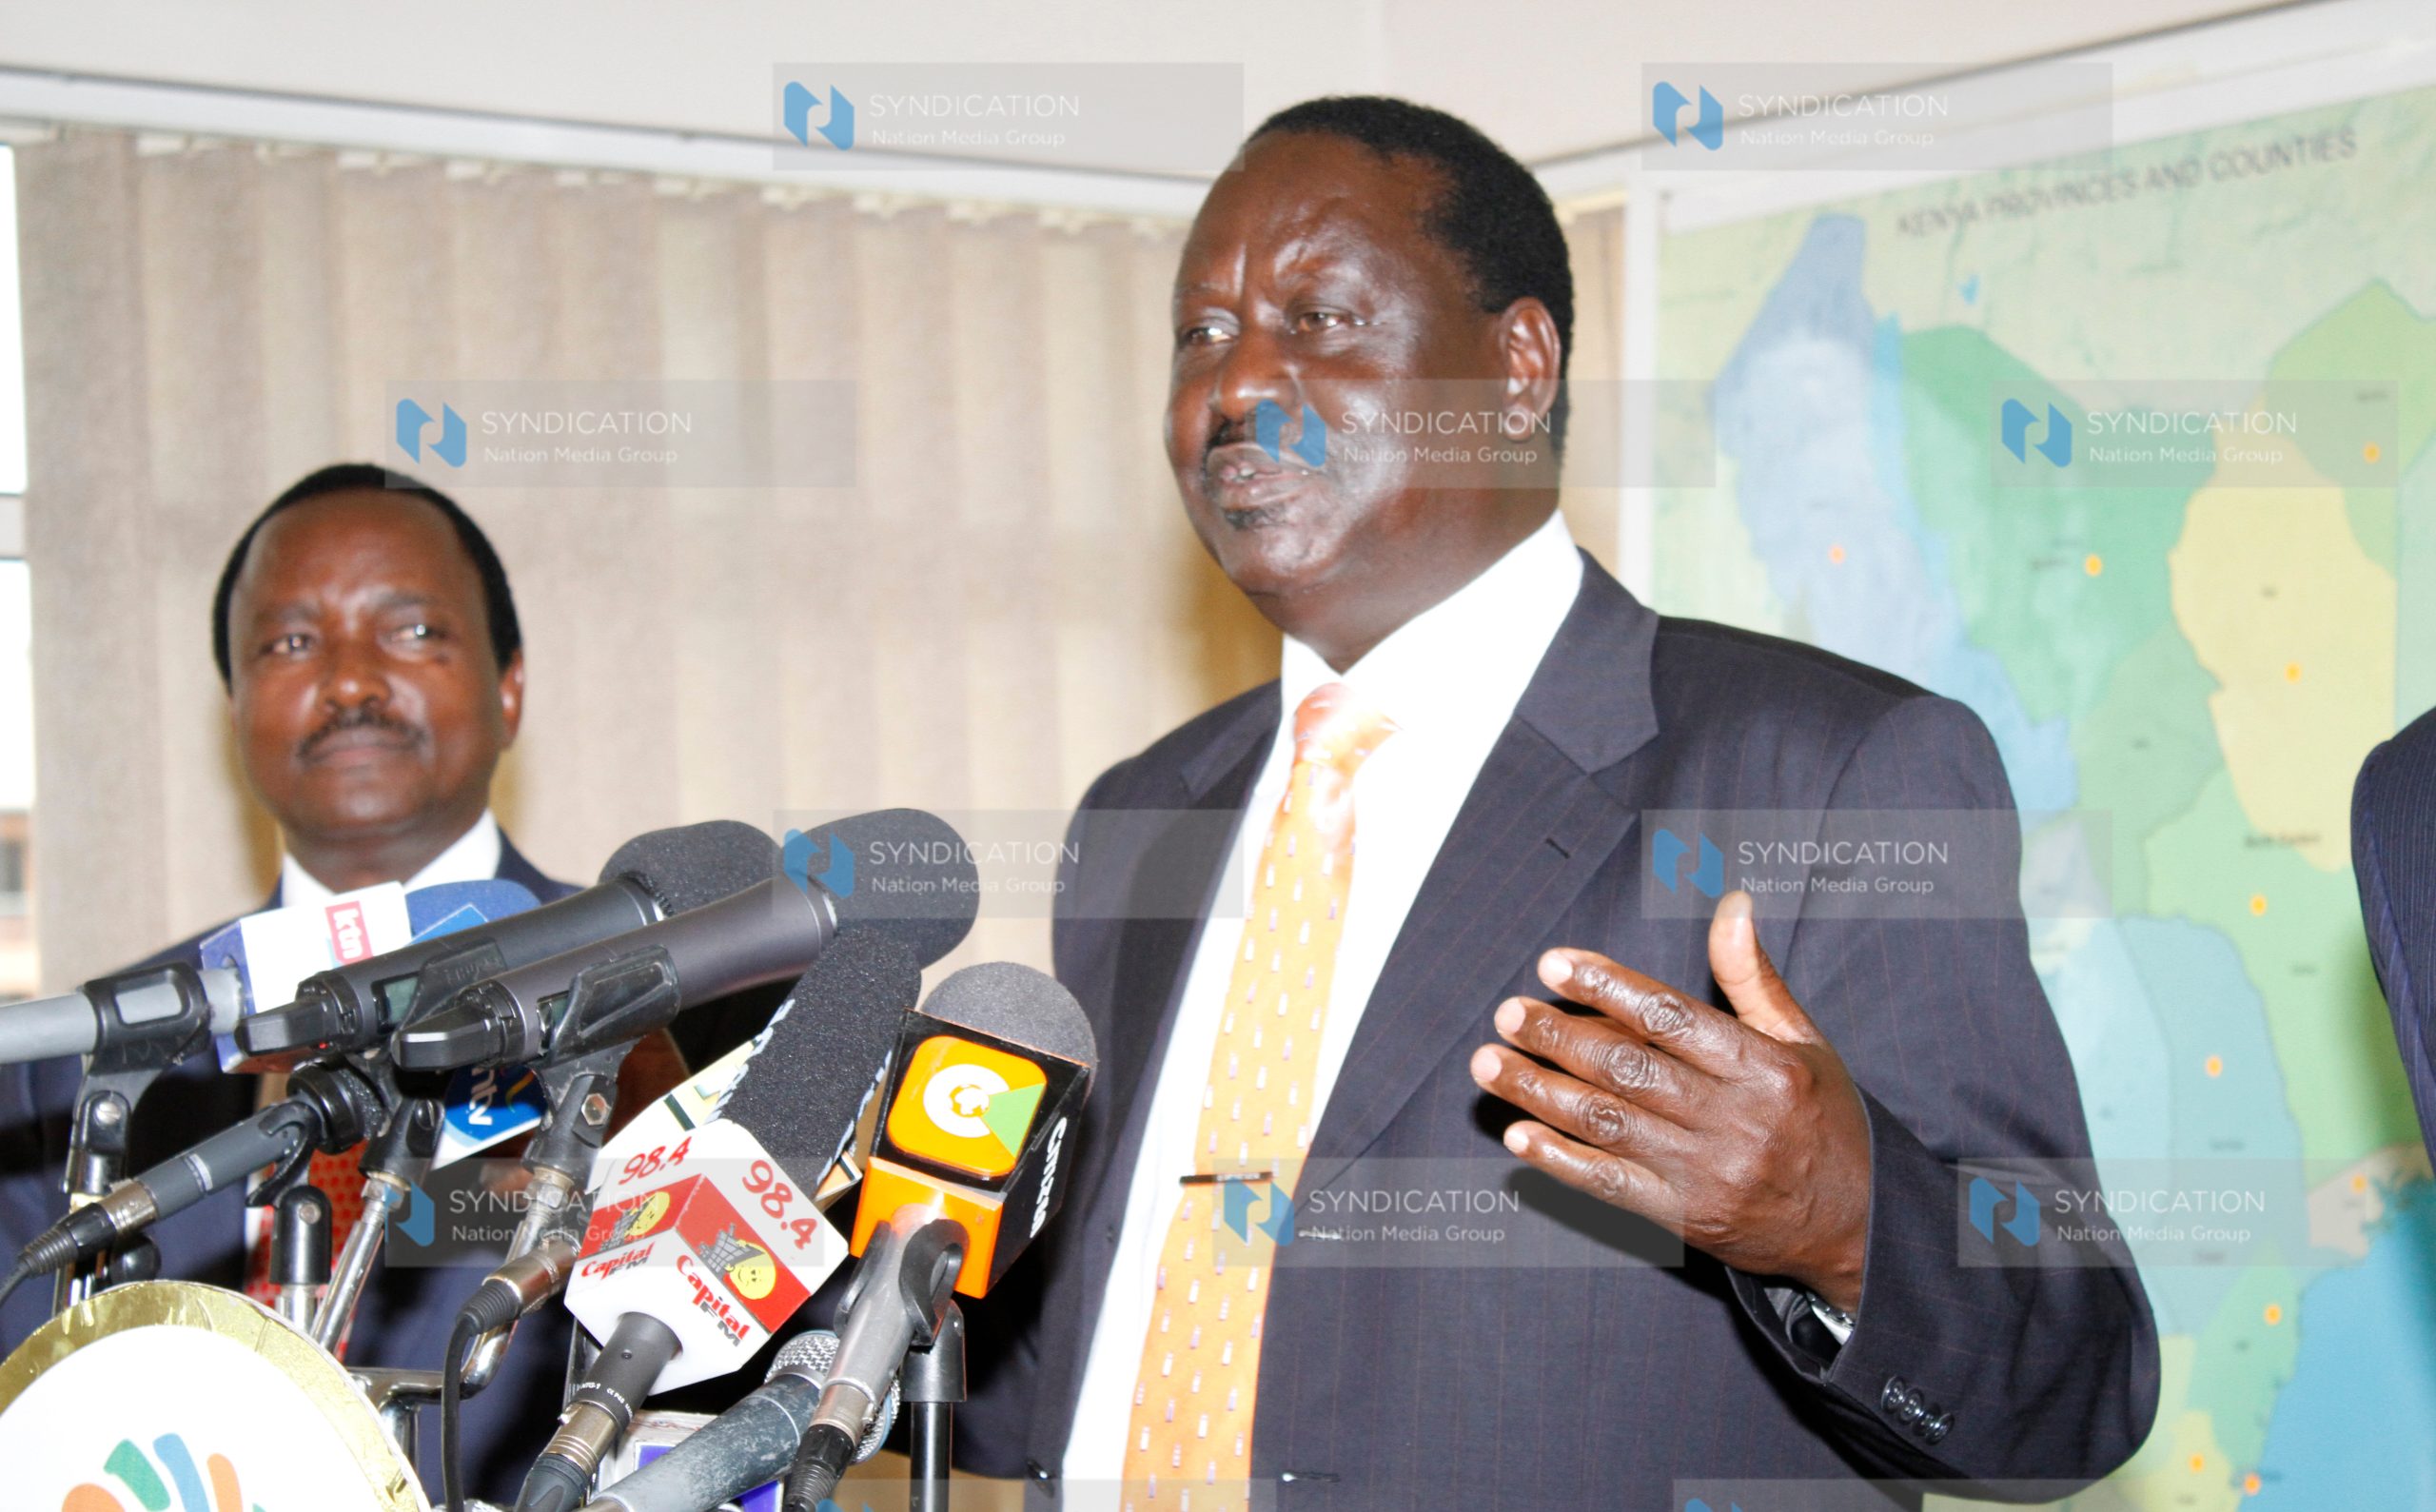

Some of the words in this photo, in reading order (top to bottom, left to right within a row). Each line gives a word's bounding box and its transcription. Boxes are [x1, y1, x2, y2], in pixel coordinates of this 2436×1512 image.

[2144, 154, 2203, 191] AND
[2207, 126, 2357, 182] COUNTIES
[332, 907, 363, 960] ktn
[618, 1135, 693, 1186] 98.4
[742, 1159, 817, 1250] 98.4
[580, 1241, 656, 1281] Capital
[607, 1256, 649, 1276] FM
[677, 1254, 751, 1341] Capital
[699, 1301, 741, 1347] FM
